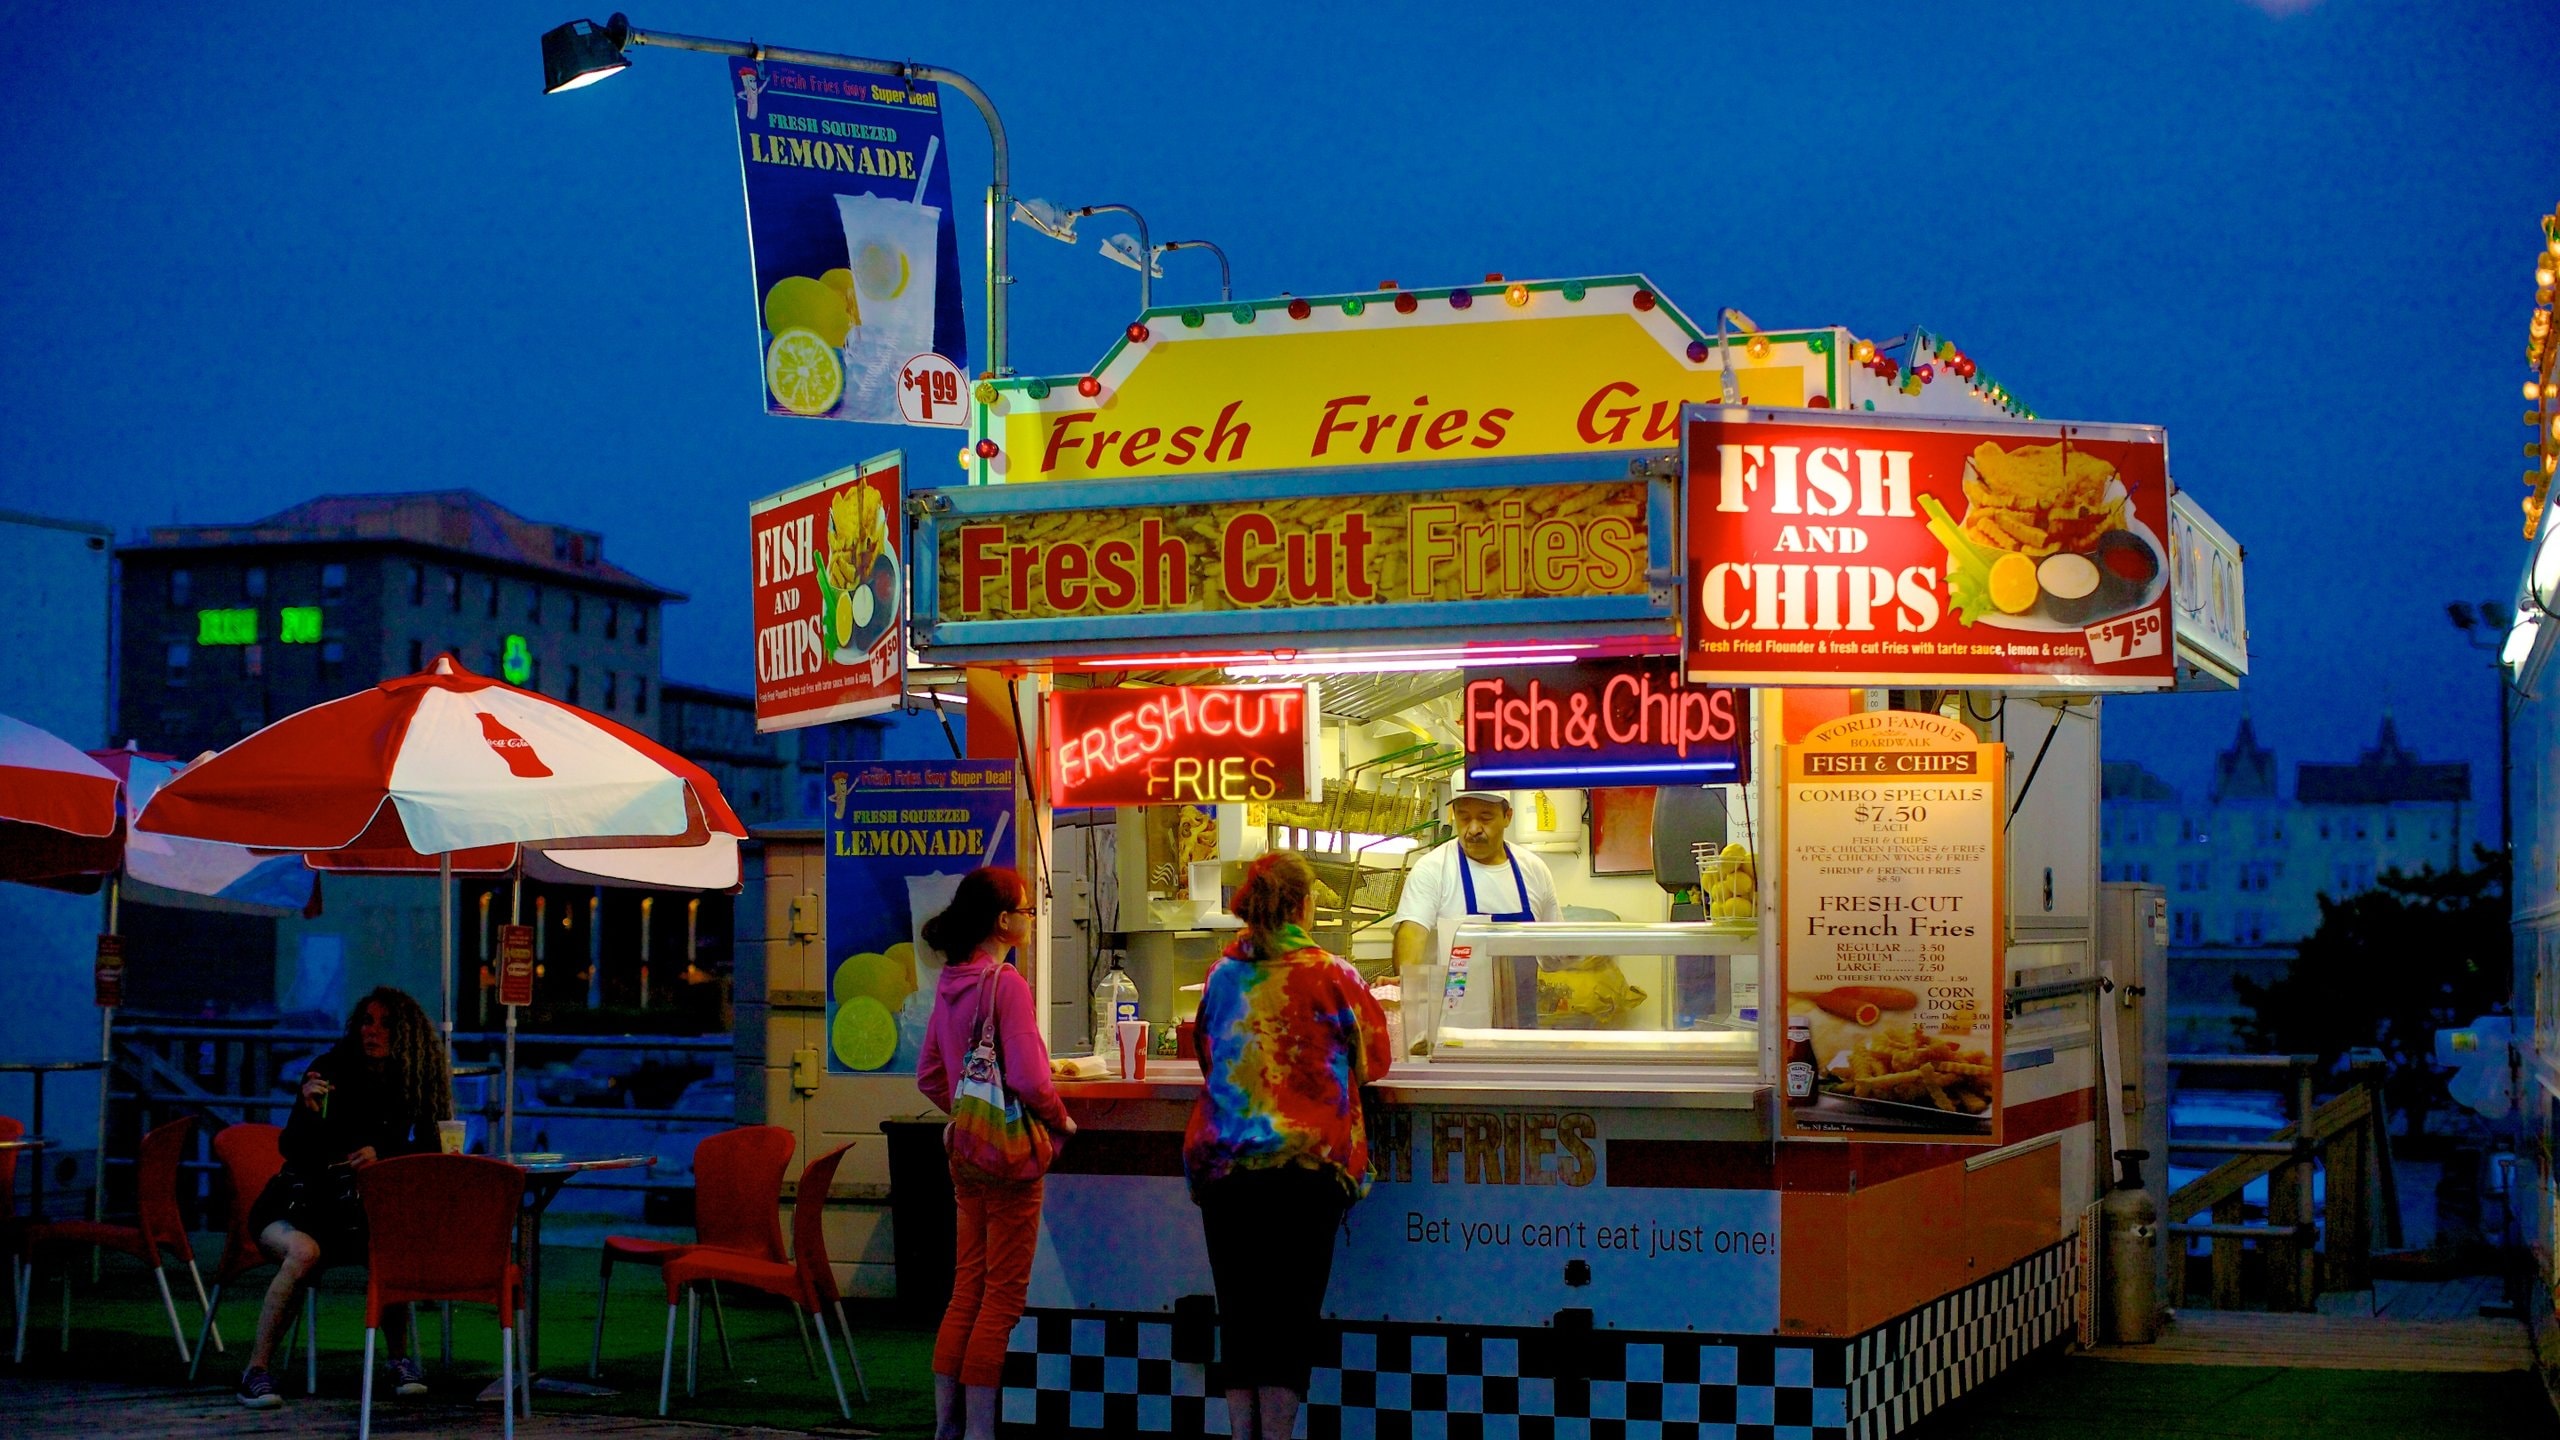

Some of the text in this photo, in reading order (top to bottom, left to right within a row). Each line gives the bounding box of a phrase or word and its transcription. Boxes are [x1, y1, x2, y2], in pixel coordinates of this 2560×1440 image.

[771, 71, 806, 90] Fresh
[871, 84, 906, 105] Super
[768, 113, 898, 143] FRESH SQUEEZED
[749, 133, 917, 180] LEMONADE
[1040, 381, 1690, 473] Fresh Fries Gu
[1716, 443, 1916, 518] FISH
[758, 514, 815, 588] FISH
[1773, 526, 1868, 554] AND
[960, 501, 1635, 615] Fresh Cut Fries
[774, 587, 800, 616] AND
[1702, 562, 1940, 634] CHIPS
[2102, 614, 2160, 658] $7.50
[758, 614, 823, 684] CHIPS
[1699, 639, 2087, 659] Fresh Fried Flounder & fresh cut Fries with tarter sauce, lemon & celery.
[1467, 671, 1736, 758] Fish & Chips
[1058, 686, 1299, 787] FRESH CUT
[1816, 716, 1966, 744] WORLD FAMOUS
[1850, 737, 1931, 748] BOARDWALK
[1812, 754, 1969, 772] FISH & CHIPS
[950, 770, 983, 787] Super
[985, 770, 1012, 785] Deal!
[1145, 757, 1276, 801] FRIES
[1799, 788, 1983, 802] COMBO SPECIALS
[853, 809, 970, 824] FRESH SQUEEZED
[1854, 803, 1927, 824] $7.50
[1872, 824, 1909, 832] EACH
[834, 829, 984, 857] LEMONADE
[1832, 845, 1884, 853] CHICKEN
[1887, 845, 1938, 853] FINGERS
[1952, 845, 1985, 853] FRIES
[1852, 836, 1879, 845] FISH
[1893, 836, 1928, 845] CHIPS
[1802, 854, 1808, 862] 6
[1811, 854, 1833, 862] PCS.
[1838, 854, 1890, 862] CHICKEN
[1894, 854, 1932, 862] WINGS
[1946, 854, 1980, 862] FRIES
[1819, 867, 1864, 875] SHRIMP
[1877, 867, 1924, 875] FRENCH
[1928, 867, 1961, 875] FRIES
[1819, 896, 1963, 912] FRESH-CUT
[1807, 914, 1975, 937] French Fries
[1836, 943, 1945, 952] REGULAR 3.50
[1836, 953, 1945, 962] MEDIUM 5.00
[1836, 963, 1945, 972] LARGE 7.50
[1927, 987, 1974, 998] CORN
[1928, 1000, 1975, 1011] DOGS
[1941, 1023, 1960, 1031] Dogs
[1942, 1013, 1957, 1021] Dog
[1972, 1013, 1990, 1021] 3.00
[1432, 1111, 1597, 1187] FRIES
[1406, 1212, 1776, 1259] Bet you can't eat just one!
